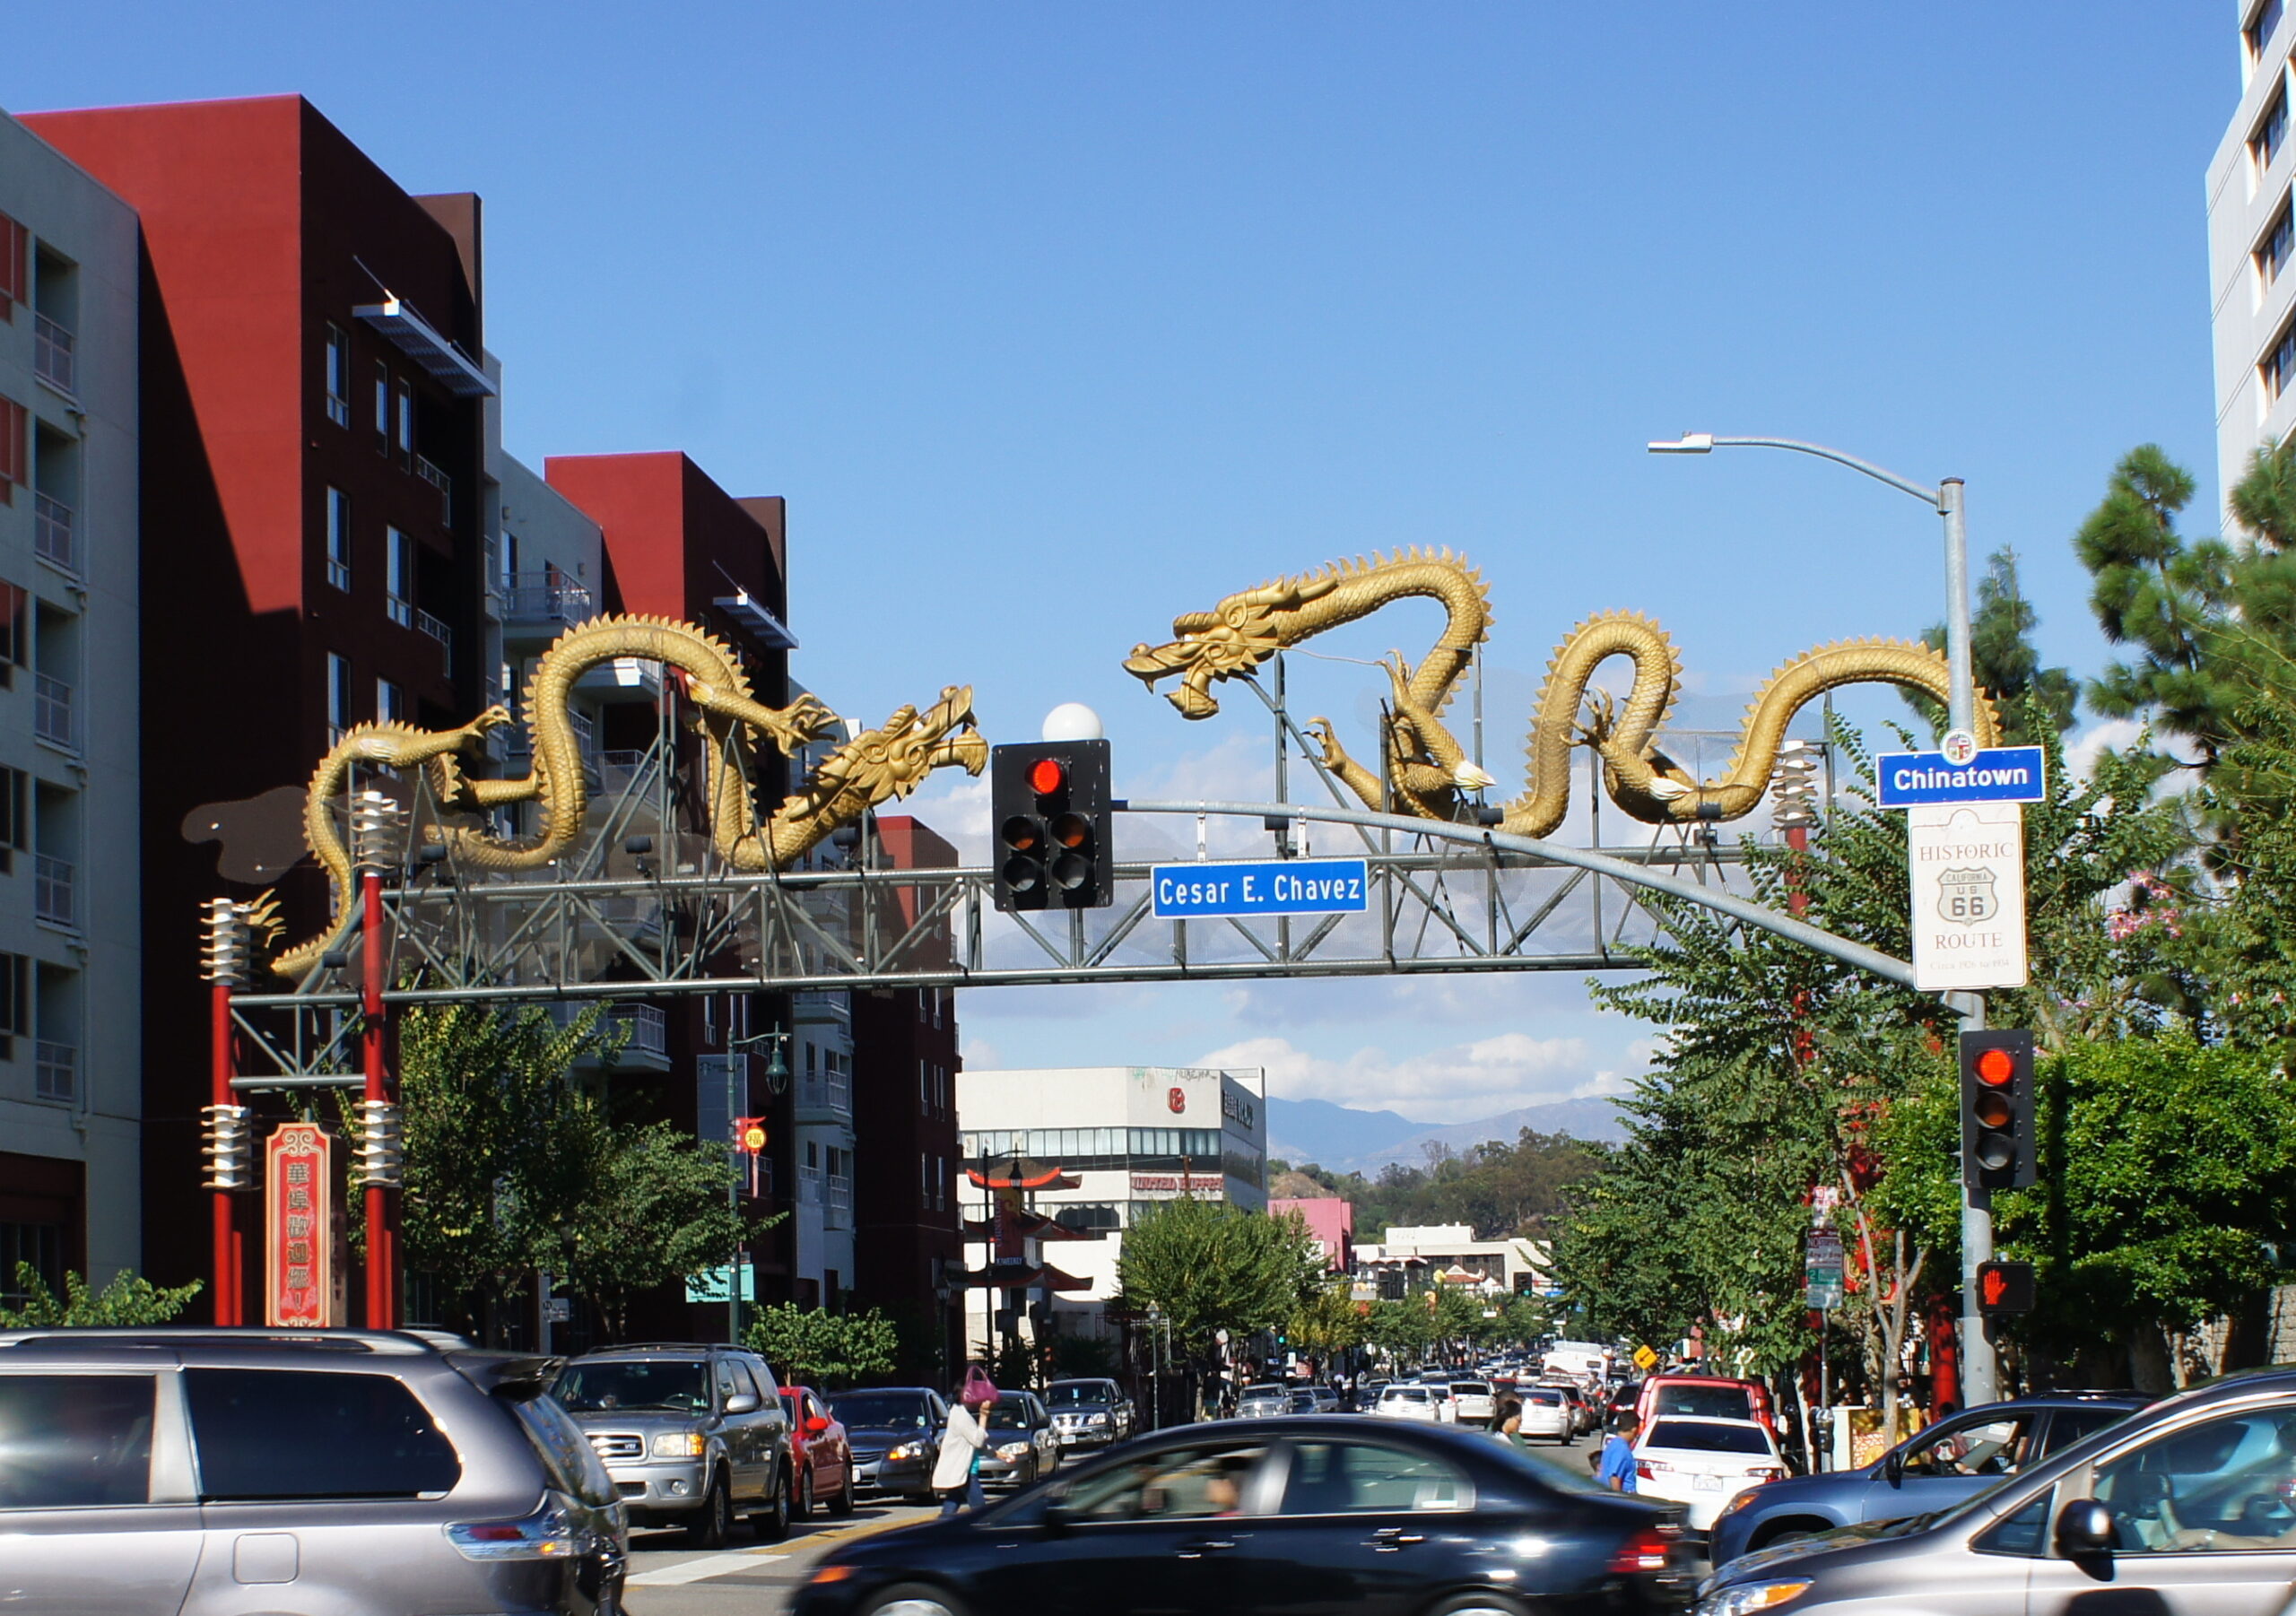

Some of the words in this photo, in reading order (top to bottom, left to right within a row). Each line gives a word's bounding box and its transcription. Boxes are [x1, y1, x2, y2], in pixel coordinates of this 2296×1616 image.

[1893, 767, 2028, 791] Chinatown
[1919, 841, 2014, 862] HISTORIC
[1945, 873, 1988, 883] CALIFORNIA
[1159, 877, 1230, 906] Cesar
[1242, 875, 1265, 903] E.
[1274, 874, 1361, 902] Chavez
[1952, 897, 1985, 917] 66
[1935, 932, 2003, 950] ROUTE
